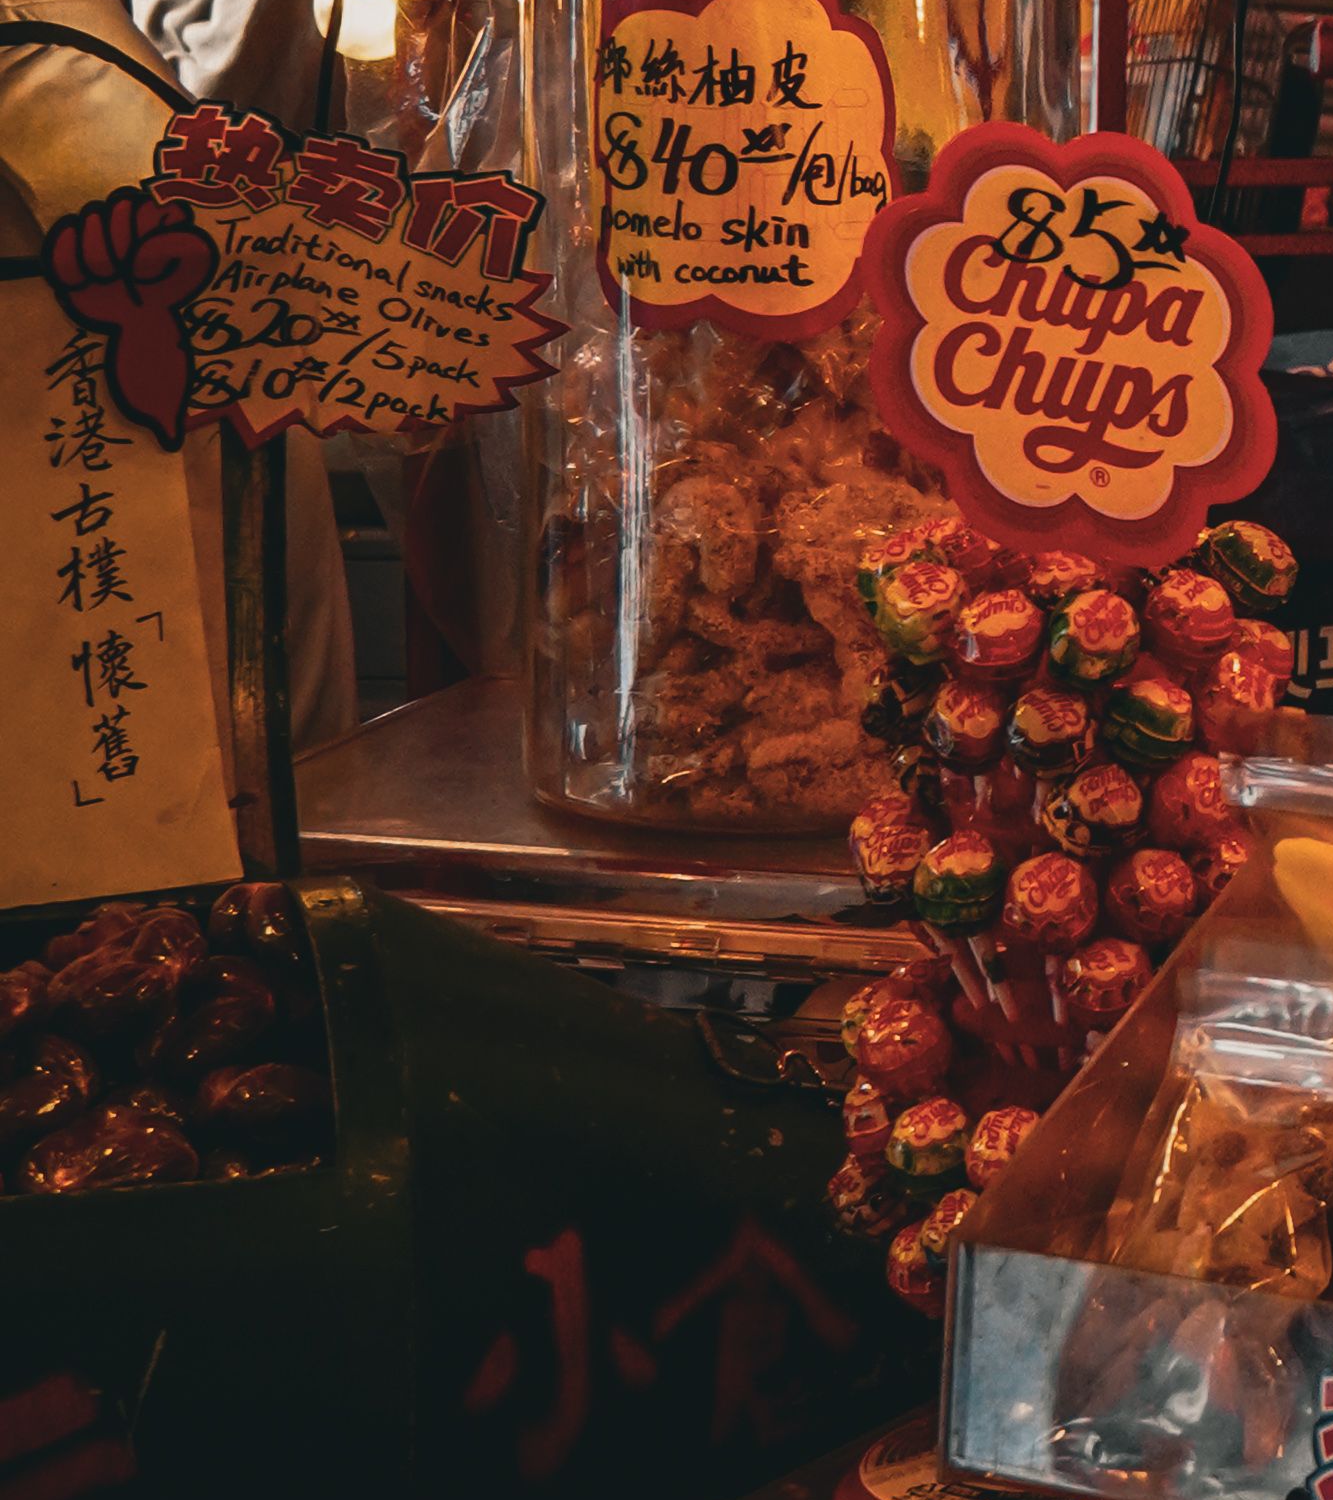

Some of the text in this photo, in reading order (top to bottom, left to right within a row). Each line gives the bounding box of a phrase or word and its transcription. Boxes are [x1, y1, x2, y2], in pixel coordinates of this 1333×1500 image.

[144, 102, 541, 281] 热卖价
[720, 205, 810, 252] skin
[212, 259, 491, 349] Airplane Olives
[216, 217, 517, 323] Traditional snacks
[616, 251, 815, 288] with coconut
[943, 234, 1205, 357] Chupa
[933, 321, 1194, 474] Chups
